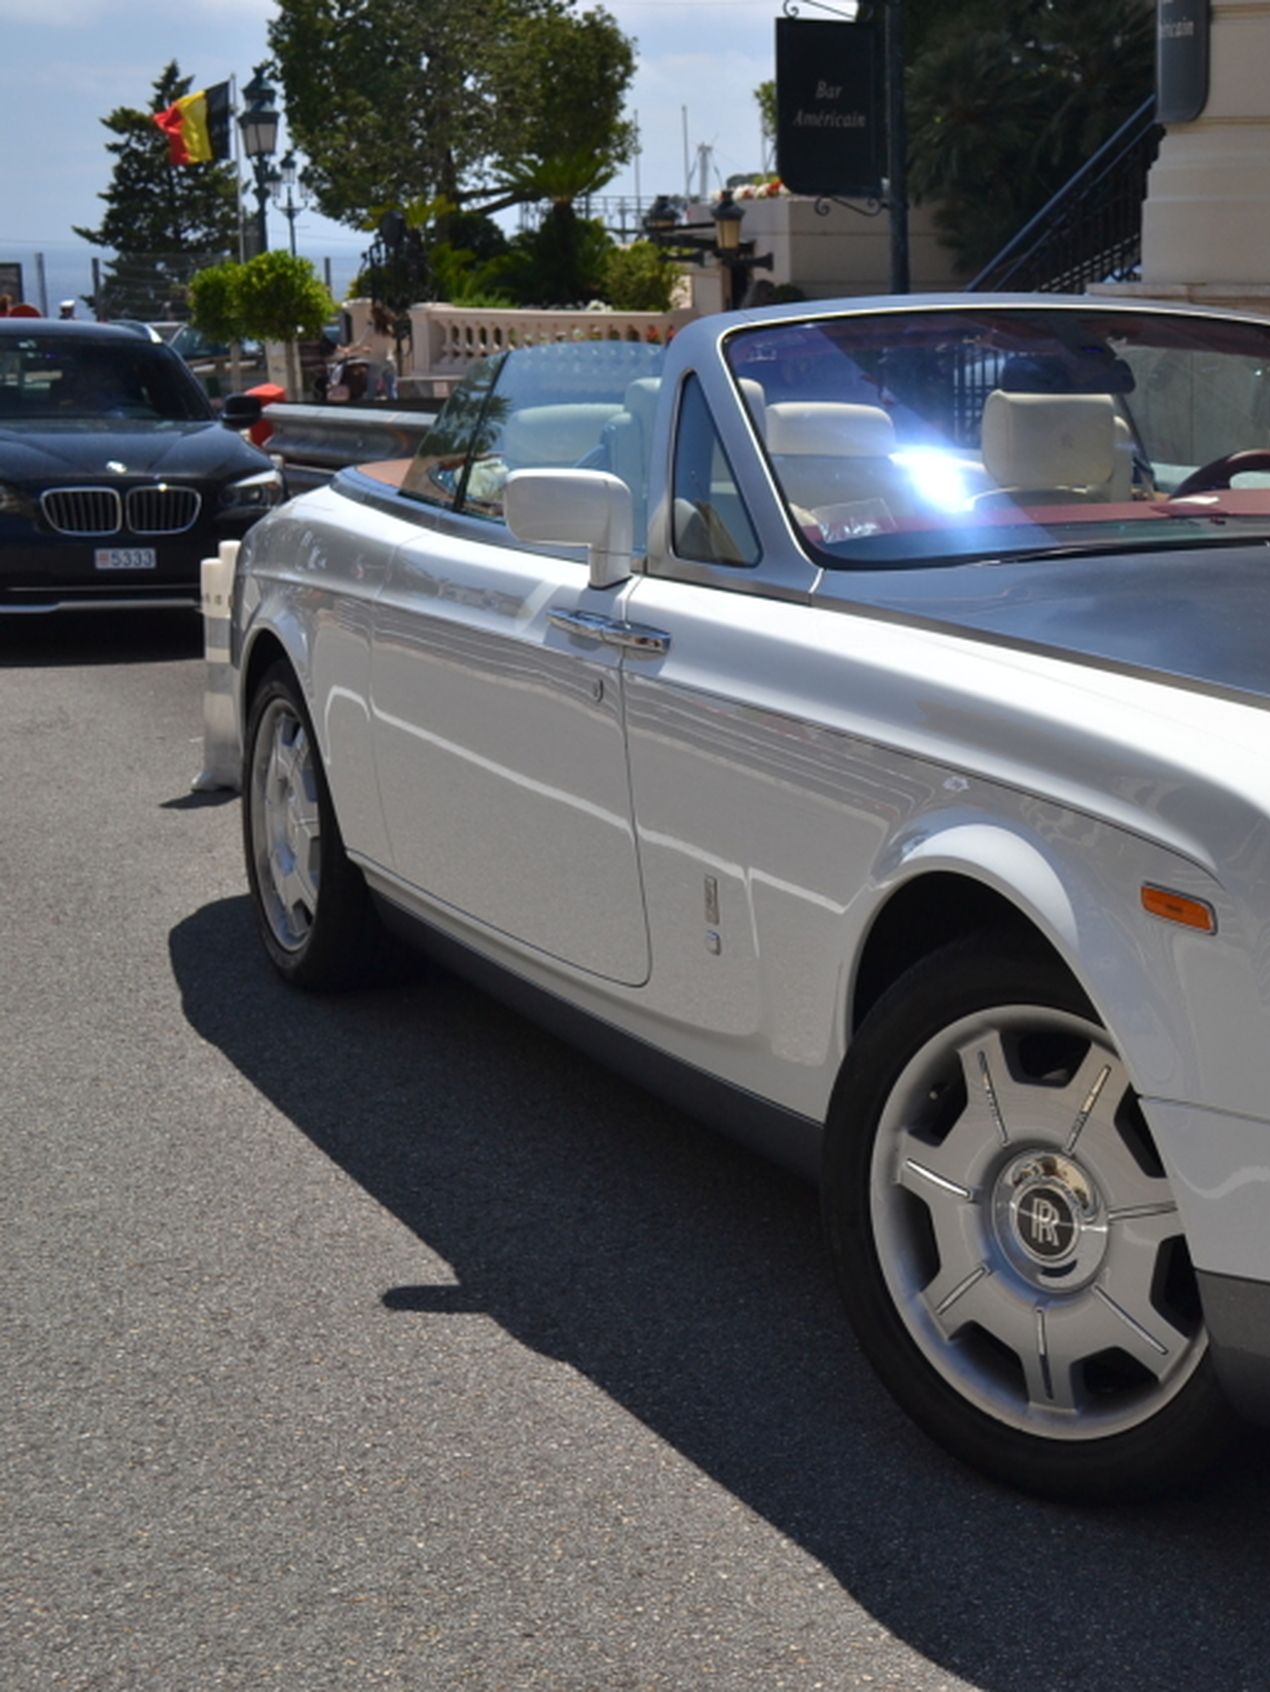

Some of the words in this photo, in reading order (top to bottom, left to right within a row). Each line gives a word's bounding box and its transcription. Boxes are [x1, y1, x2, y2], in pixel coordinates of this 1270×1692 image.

[815, 79, 843, 99] Bar
[793, 108, 867, 128] Américain
[111, 549, 153, 567] 5333
